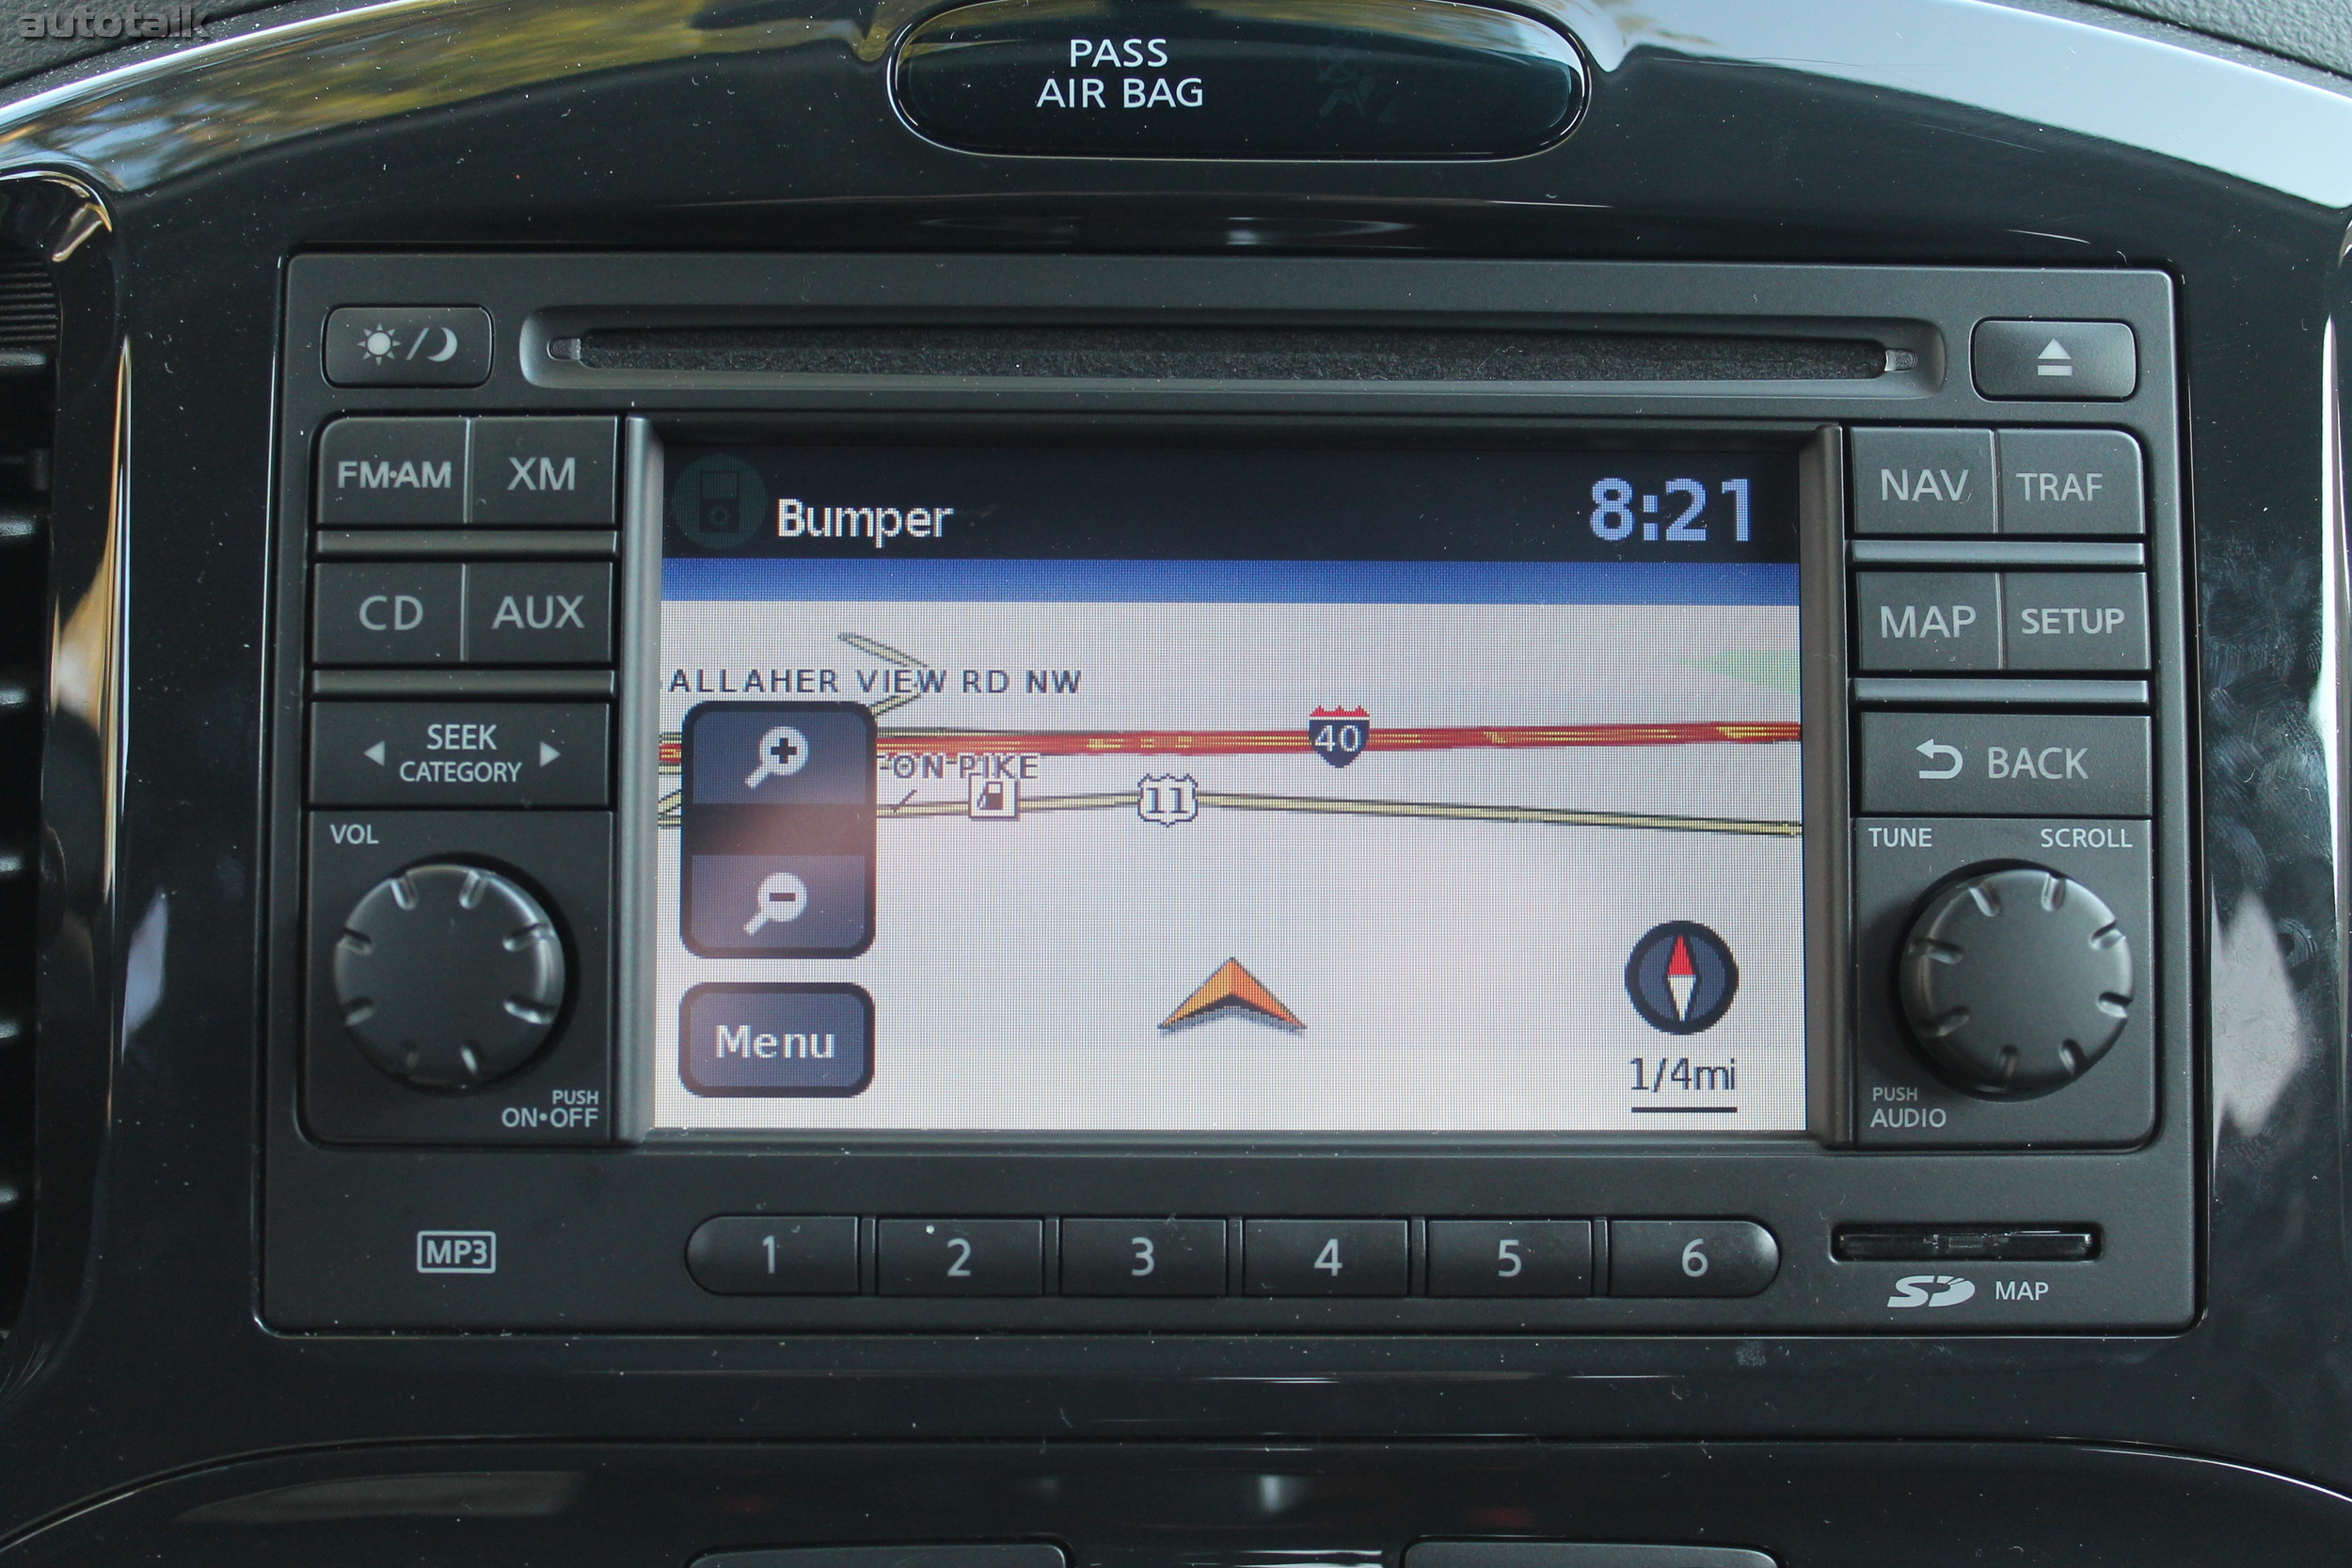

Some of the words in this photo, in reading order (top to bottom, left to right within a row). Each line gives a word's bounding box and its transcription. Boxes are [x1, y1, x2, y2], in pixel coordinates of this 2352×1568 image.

[1069, 38, 1169, 70] PASS
[1036, 77, 1106, 109] AIR
[1122, 77, 1204, 109] BAG
[507, 456, 577, 491] XM
[1880, 468, 1970, 502] NAV
[2016, 472, 2105, 502] TRAF
[776, 499, 954, 549] Bumper
[1589, 476, 1753, 544] 8:21
[358, 594, 424, 632] CD
[491, 594, 586, 630] AUX
[1880, 604, 1977, 640] MAP
[2020, 607, 2126, 636] SETUP
[659, 669, 839, 693] ALLAHER
[856, 669, 946, 694] VIEW
[962, 669, 1009, 694] RD
[1027, 669, 1082, 694] NW
[426, 722, 498, 752] SEEK
[1314, 723, 1360, 753] 40
[399, 760, 523, 784] CATEGORY
[959, 753, 1039, 780] PIKE
[1987, 748, 2089, 779] BACK
[1146, 786, 1189, 815] 11
[329, 825, 379, 846] VOL
[1868, 828, 1932, 848] TUNE
[2040, 827, 2133, 849] SCROLL
[715, 1024, 834, 1059] Menu
[1629, 1058, 1737, 1093] 1/4mi
[551, 1088, 599, 1106] PUSH
[1871, 1086, 1918, 1103] PUSH
[1869, 1108, 1947, 1128] AUDIO
[424, 1237, 488, 1268] MP3
[761, 1235, 777, 1275] 1
[946, 1239, 972, 1276] 2
[1130, 1237, 1155, 1275] 3
[1313, 1238, 1343, 1277] 4
[1497, 1239, 1522, 1276] 5
[1680, 1239, 1709, 1277] 6
[1994, 1280, 2049, 1302] MAP
